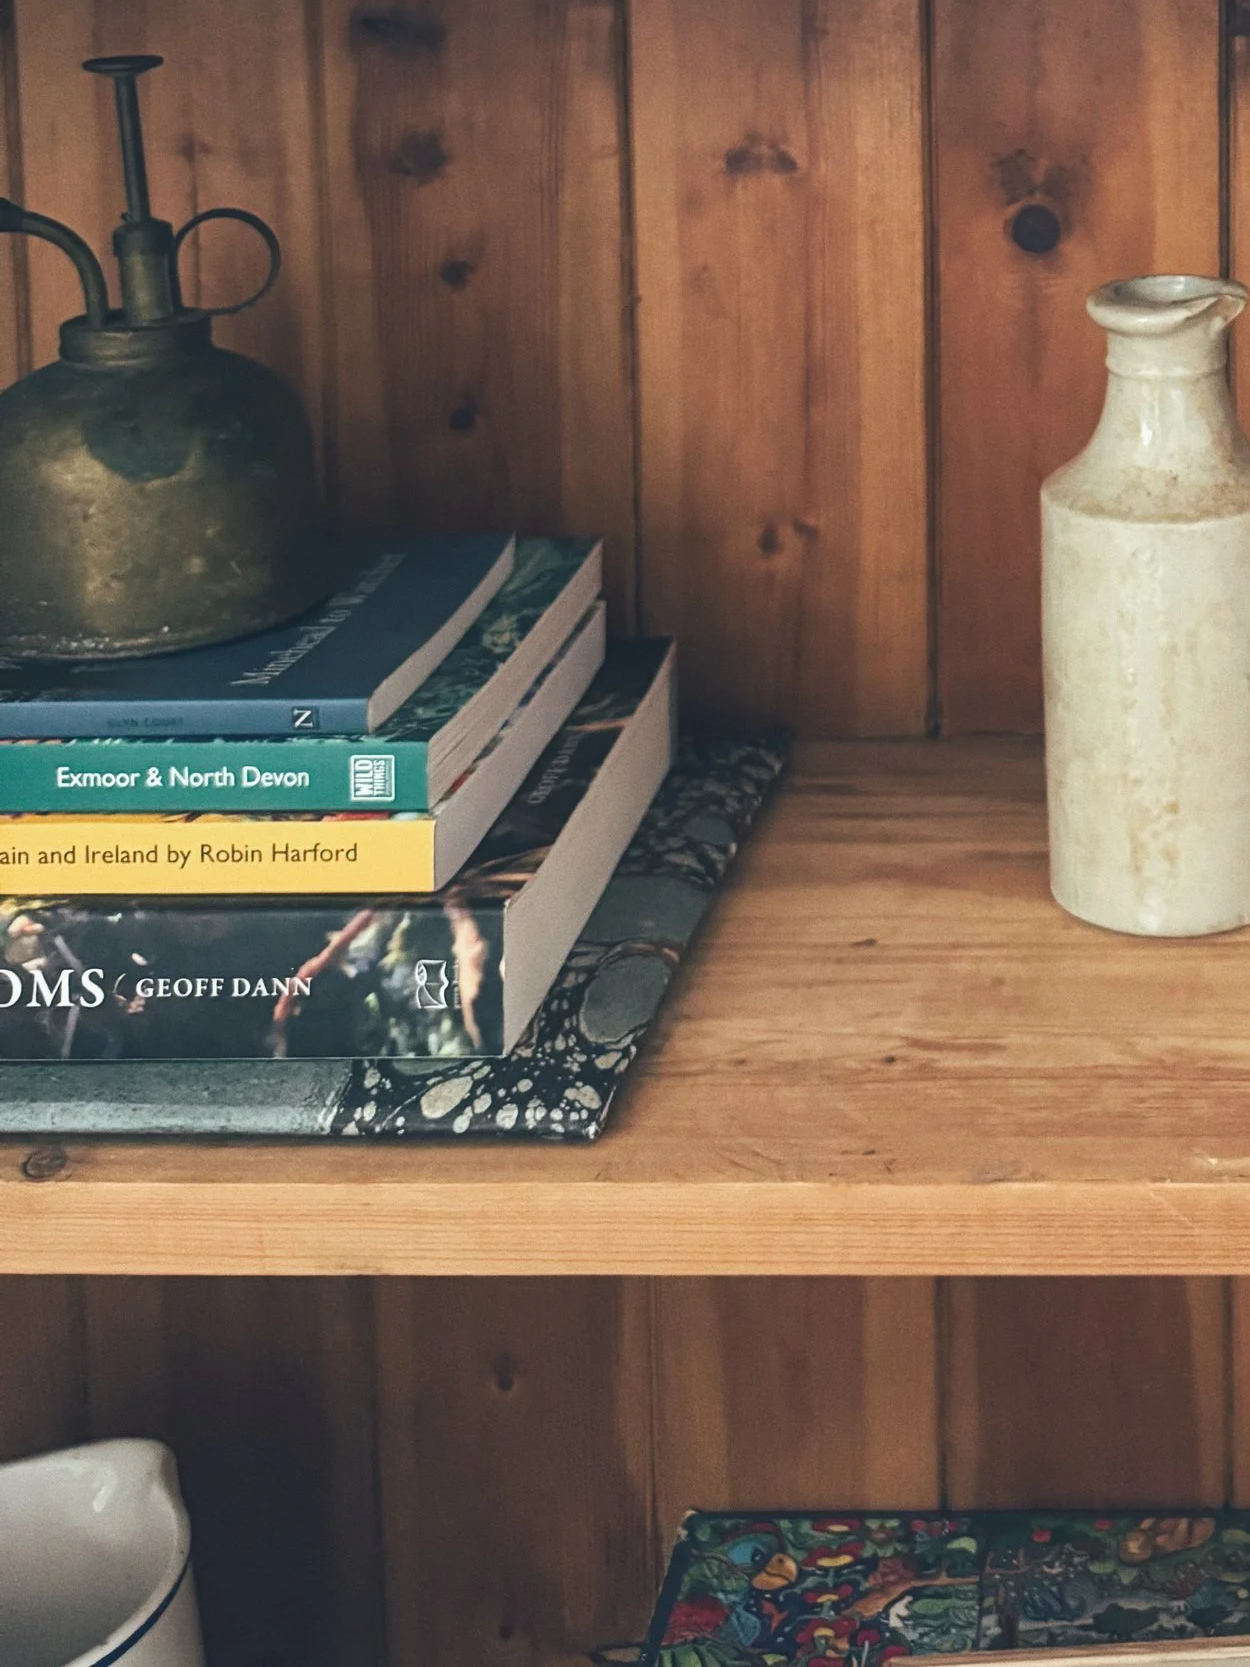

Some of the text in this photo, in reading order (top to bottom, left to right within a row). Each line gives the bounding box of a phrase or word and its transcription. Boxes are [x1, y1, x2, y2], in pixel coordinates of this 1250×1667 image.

[57, 765, 310, 788] Exmoor & North Devon
[355, 759, 374, 797] WILD
[374, 759, 385, 797] THINGS
[0, 843, 358, 869] ain and Ireland by Robin Harford
[136, 977, 224, 998] GEOFF
[232, 977, 312, 998] DANN
